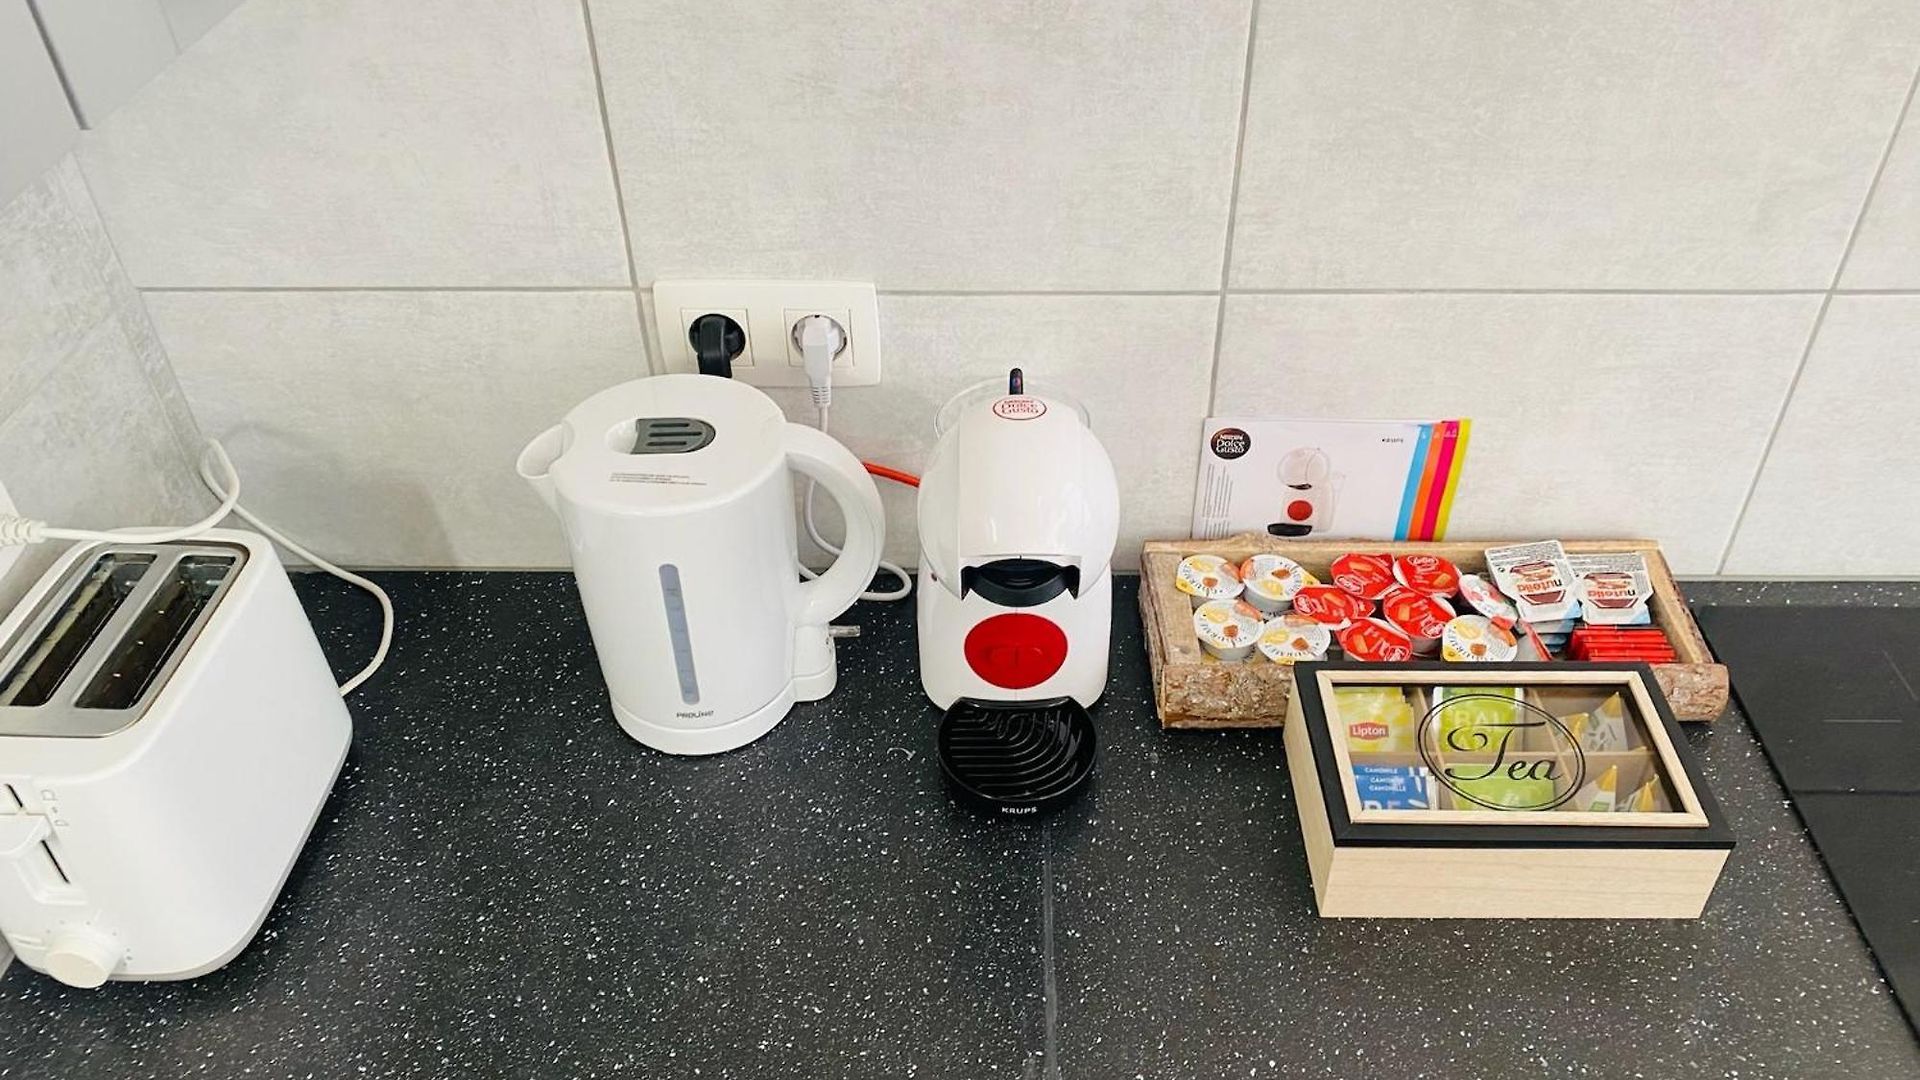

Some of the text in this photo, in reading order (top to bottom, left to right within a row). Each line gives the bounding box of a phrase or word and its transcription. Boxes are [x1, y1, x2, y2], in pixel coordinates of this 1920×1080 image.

[1516, 579, 1563, 594] nutella
[1588, 588, 1636, 599] nutella
[1352, 725, 1386, 737] Lipton
[1443, 721, 1564, 781] Tea
[1001, 806, 1038, 814] KRUPS
